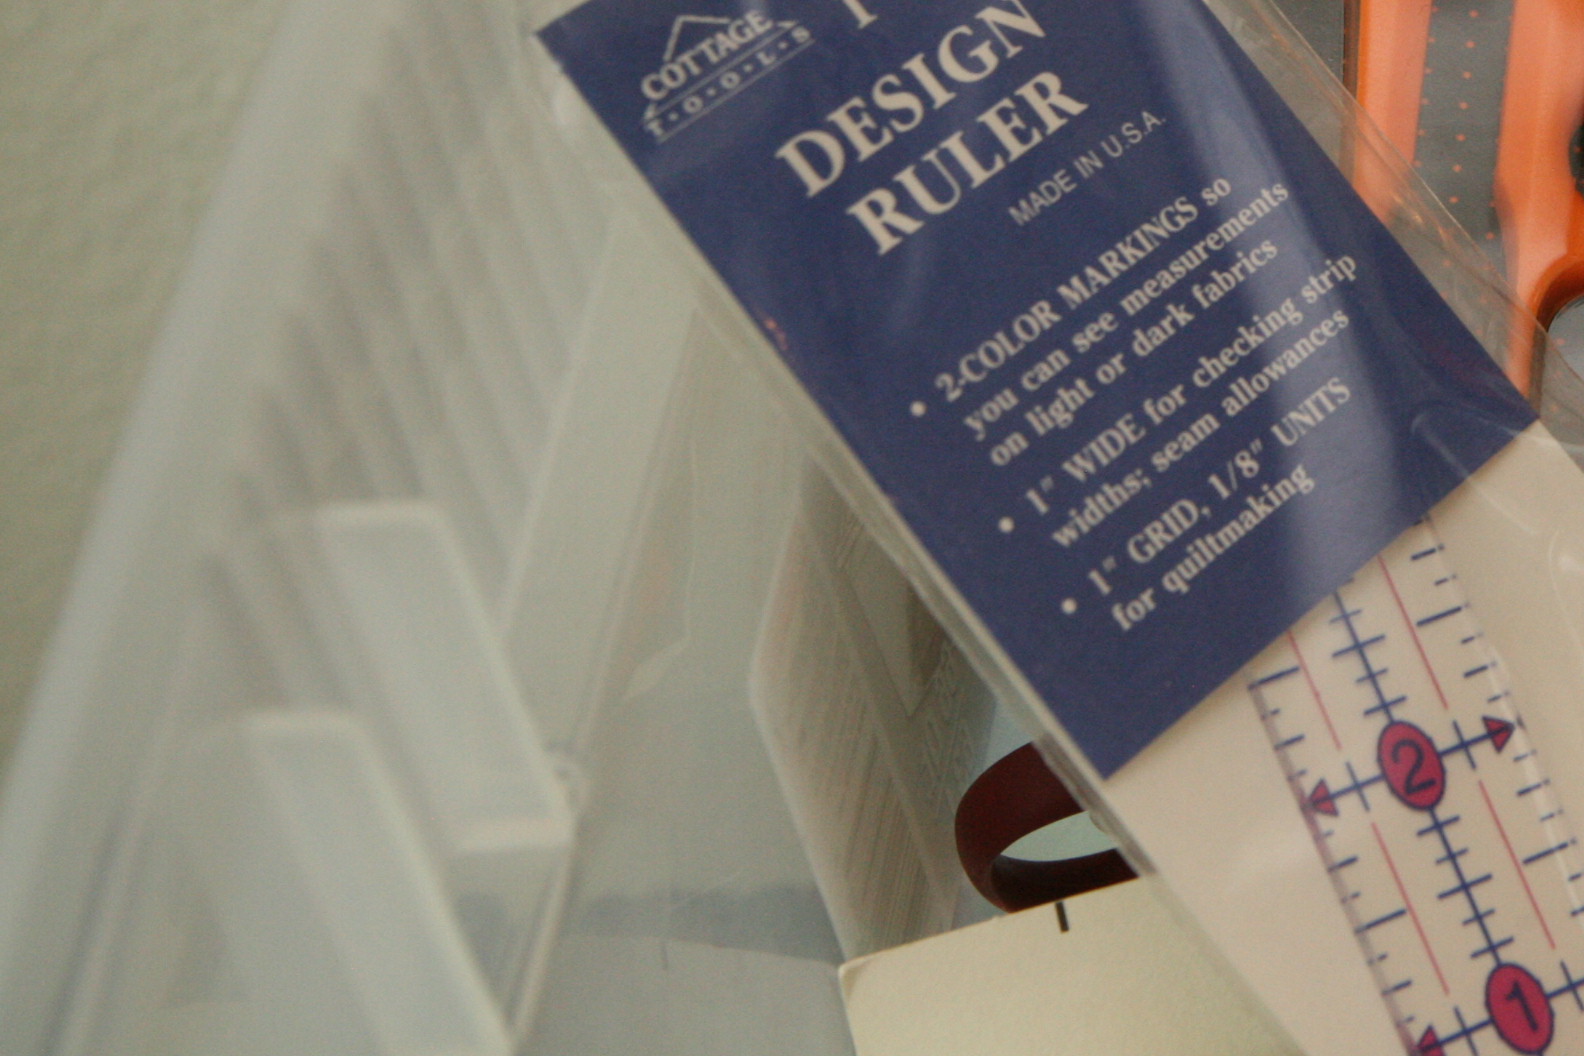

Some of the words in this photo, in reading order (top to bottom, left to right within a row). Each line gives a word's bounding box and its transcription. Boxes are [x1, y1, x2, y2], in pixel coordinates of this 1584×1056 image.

[641, 10, 774, 100] COTTAGE
[846, 70, 1089, 255] RULER
[1008, 169, 1077, 226] MADE
[1074, 150, 1104, 178] IN
[1100, 111, 1166, 158] U.S.A.
[935, 300, 1061, 403] 2-COLOR
[1057, 196, 1198, 310] MARKINGS
[1201, 178, 1232, 206] so
[963, 389, 1018, 442] you
[1021, 348, 1070, 392] can
[1073, 310, 1119, 354] see
[1120, 181, 1289, 316] measurements
[990, 431, 1029, 467] on
[1026, 375, 1095, 432] light
[1095, 350, 1127, 386] or
[1132, 301, 1195, 358] dark
[1191, 238, 1279, 310] fabrics
[1062, 415, 1146, 484] WIDE
[1144, 382, 1187, 426] for
[1192, 297, 1304, 388] checking
[1300, 254, 1358, 306] strip
[1052, 466, 1153, 548] widths;
[1151, 412, 1222, 473] seam
[1221, 306, 1350, 417] allowances
[1126, 497, 1212, 566] GRID,
[1207, 439, 1264, 500] 1/8"
[1271, 376, 1351, 447] UNITS
[1112, 596, 1158, 632] for
[1161, 463, 1315, 596] quiltmaking
[1391, 738, 1437, 796] 2
[1504, 980, 1540, 1034] 1
